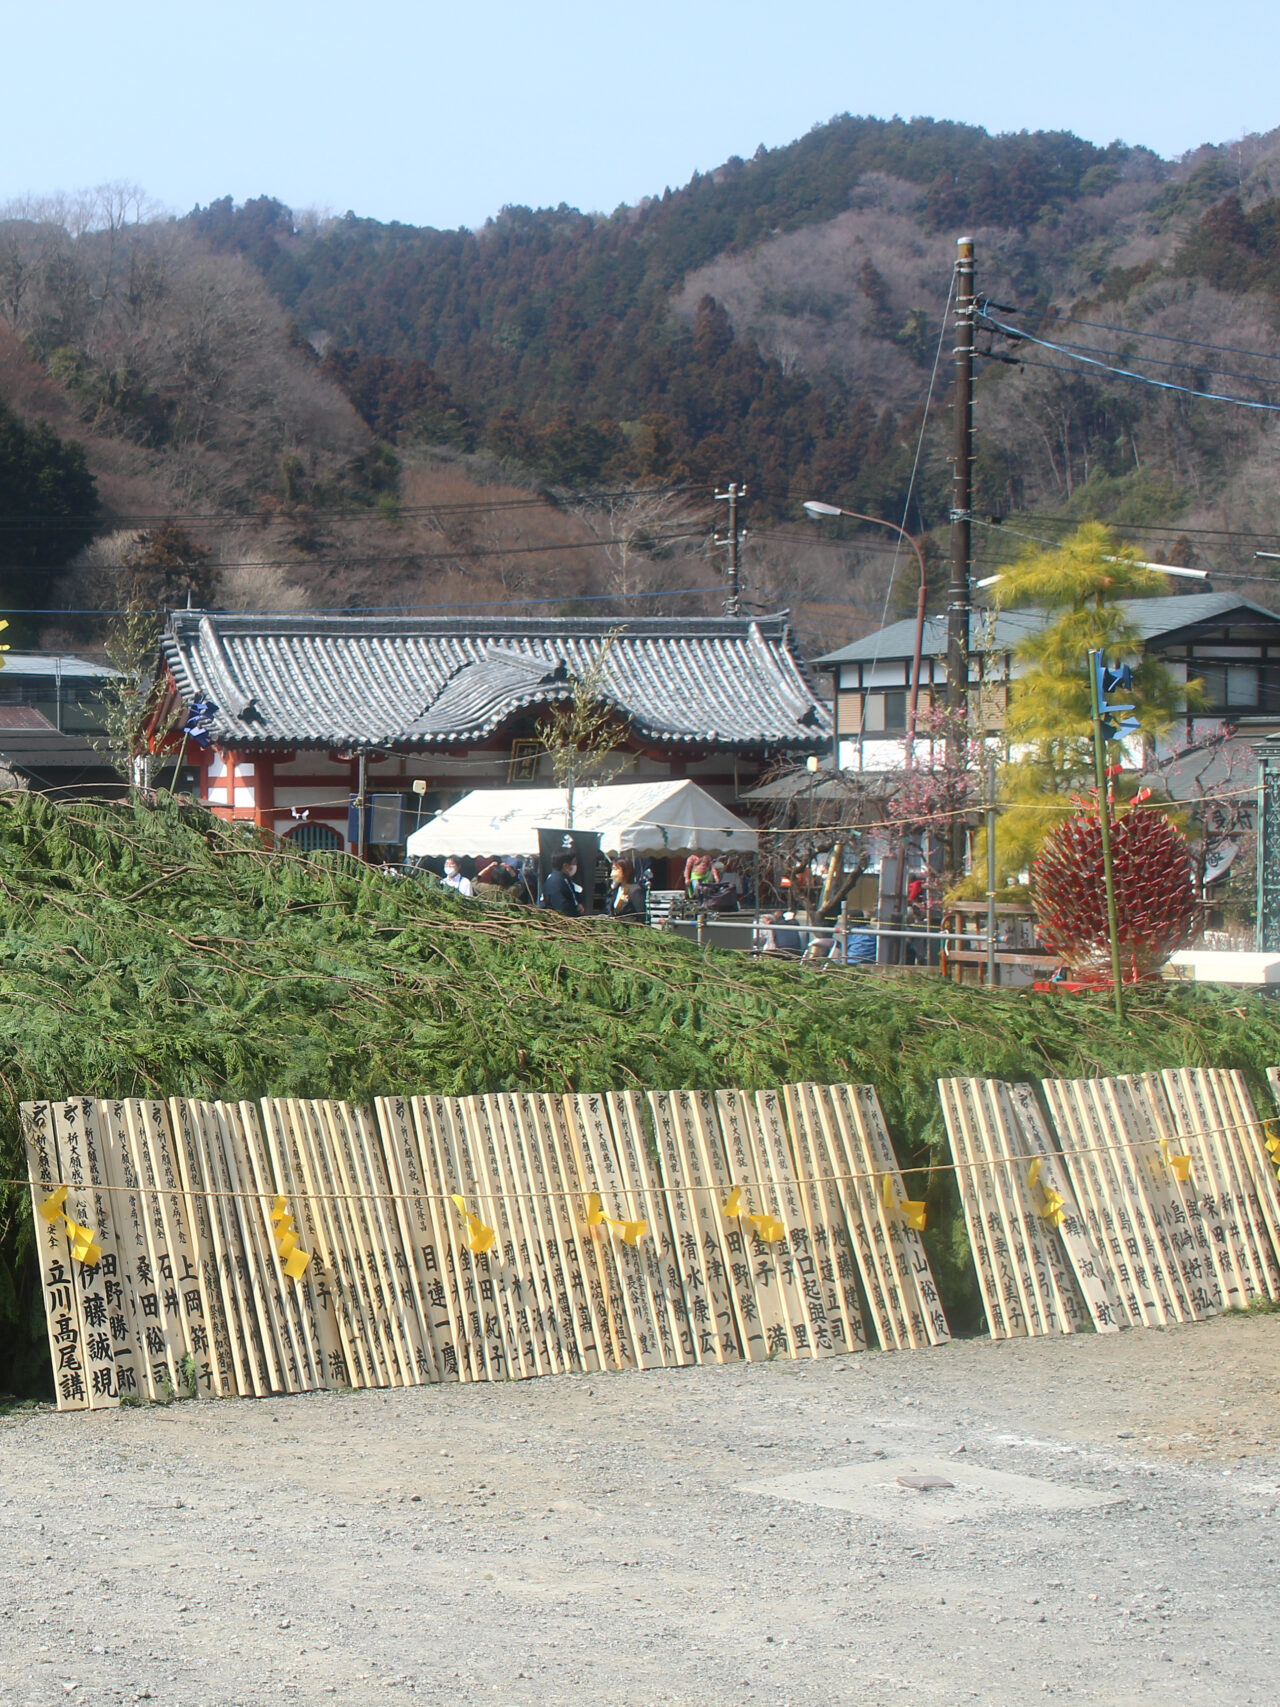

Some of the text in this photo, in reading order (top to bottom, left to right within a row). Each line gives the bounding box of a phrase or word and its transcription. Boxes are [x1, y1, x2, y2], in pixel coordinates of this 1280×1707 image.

[36, 1134, 54, 1193] 祈大願成就
[66, 1132, 119, 1399] 祈大願成就 心願成 伊藤誠規
[84, 1128, 102, 1185] 祈大願成就
[101, 1253, 137, 1392] 田野勝一郎
[118, 1130, 170, 1385] 祈大願成就 桑田裕司
[157, 1130, 214, 1390] 祈大願成就 上岡節子
[311, 1247, 346, 1382] 金子満
[679, 1231, 717, 1355] 清水康広
[703, 1231, 737, 1354] 今津いづみ
[749, 1229, 788, 1353] 金子満
